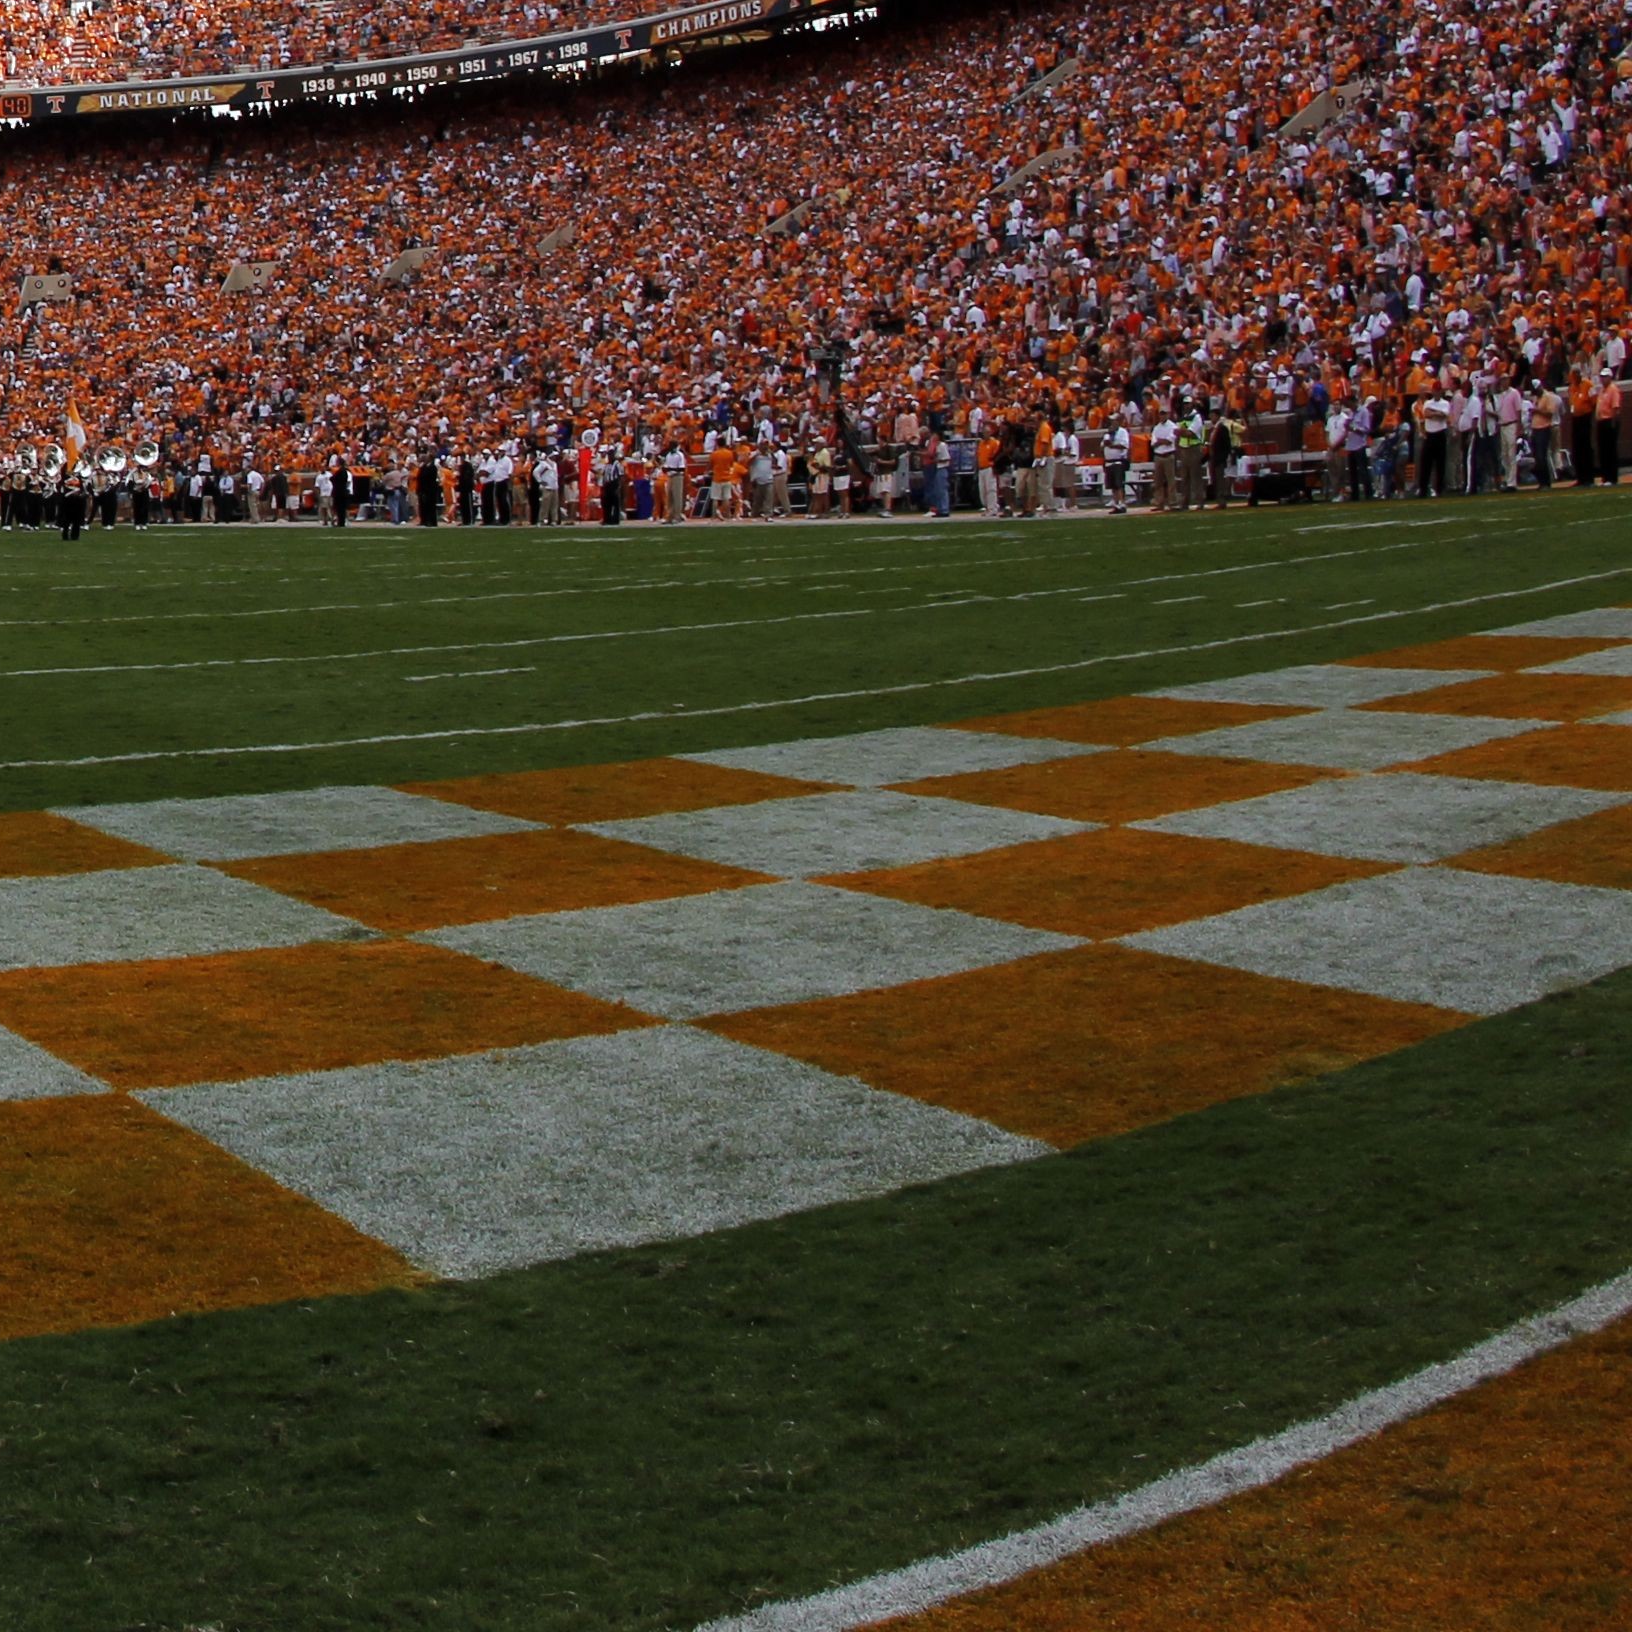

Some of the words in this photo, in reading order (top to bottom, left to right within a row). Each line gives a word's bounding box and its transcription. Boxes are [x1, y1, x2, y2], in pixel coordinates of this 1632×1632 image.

[656, 0, 762, 39] CHAMPIONS
[301, 78, 335, 93] 1938
[355, 72, 386, 88] 1940
[406, 66, 437, 82] 1950
[458, 58, 487, 74] 1951
[508, 50, 538, 67] 1967
[558, 41, 587, 59] 1998
[99, 88, 216, 108] NATIONAL
